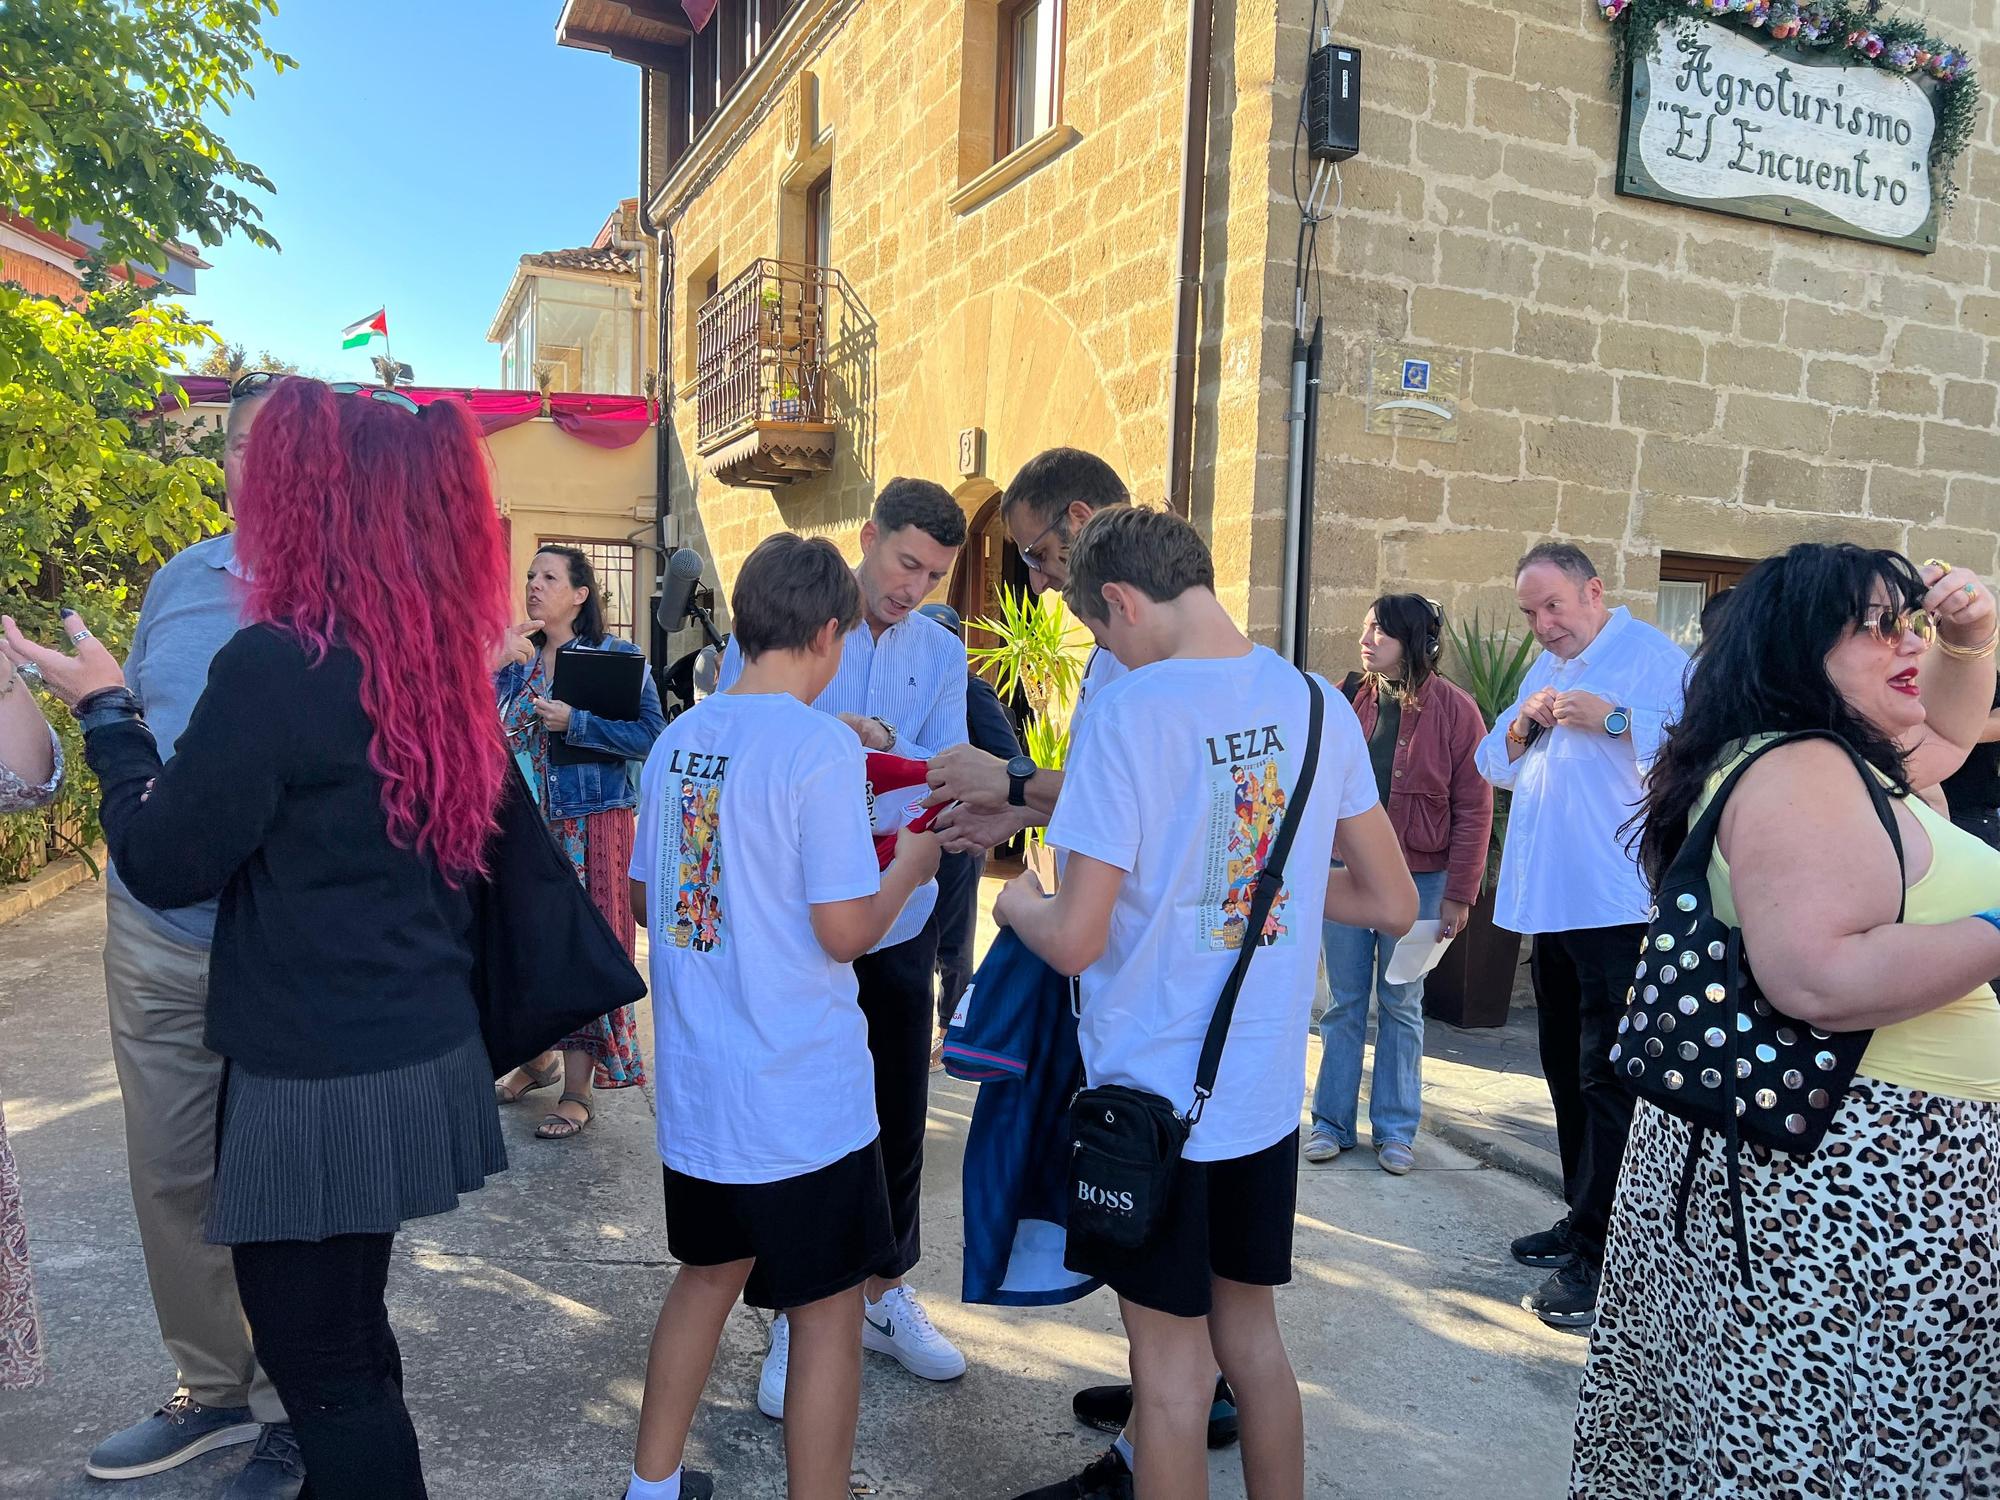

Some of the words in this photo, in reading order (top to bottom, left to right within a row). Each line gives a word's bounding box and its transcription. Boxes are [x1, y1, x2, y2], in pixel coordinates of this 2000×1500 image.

[1676, 38, 1912, 146] Agroturismo
[1206, 724, 1285, 766] LEZA
[669, 750, 729, 781] LEZA
[1078, 1180, 1134, 1210] BOSS
